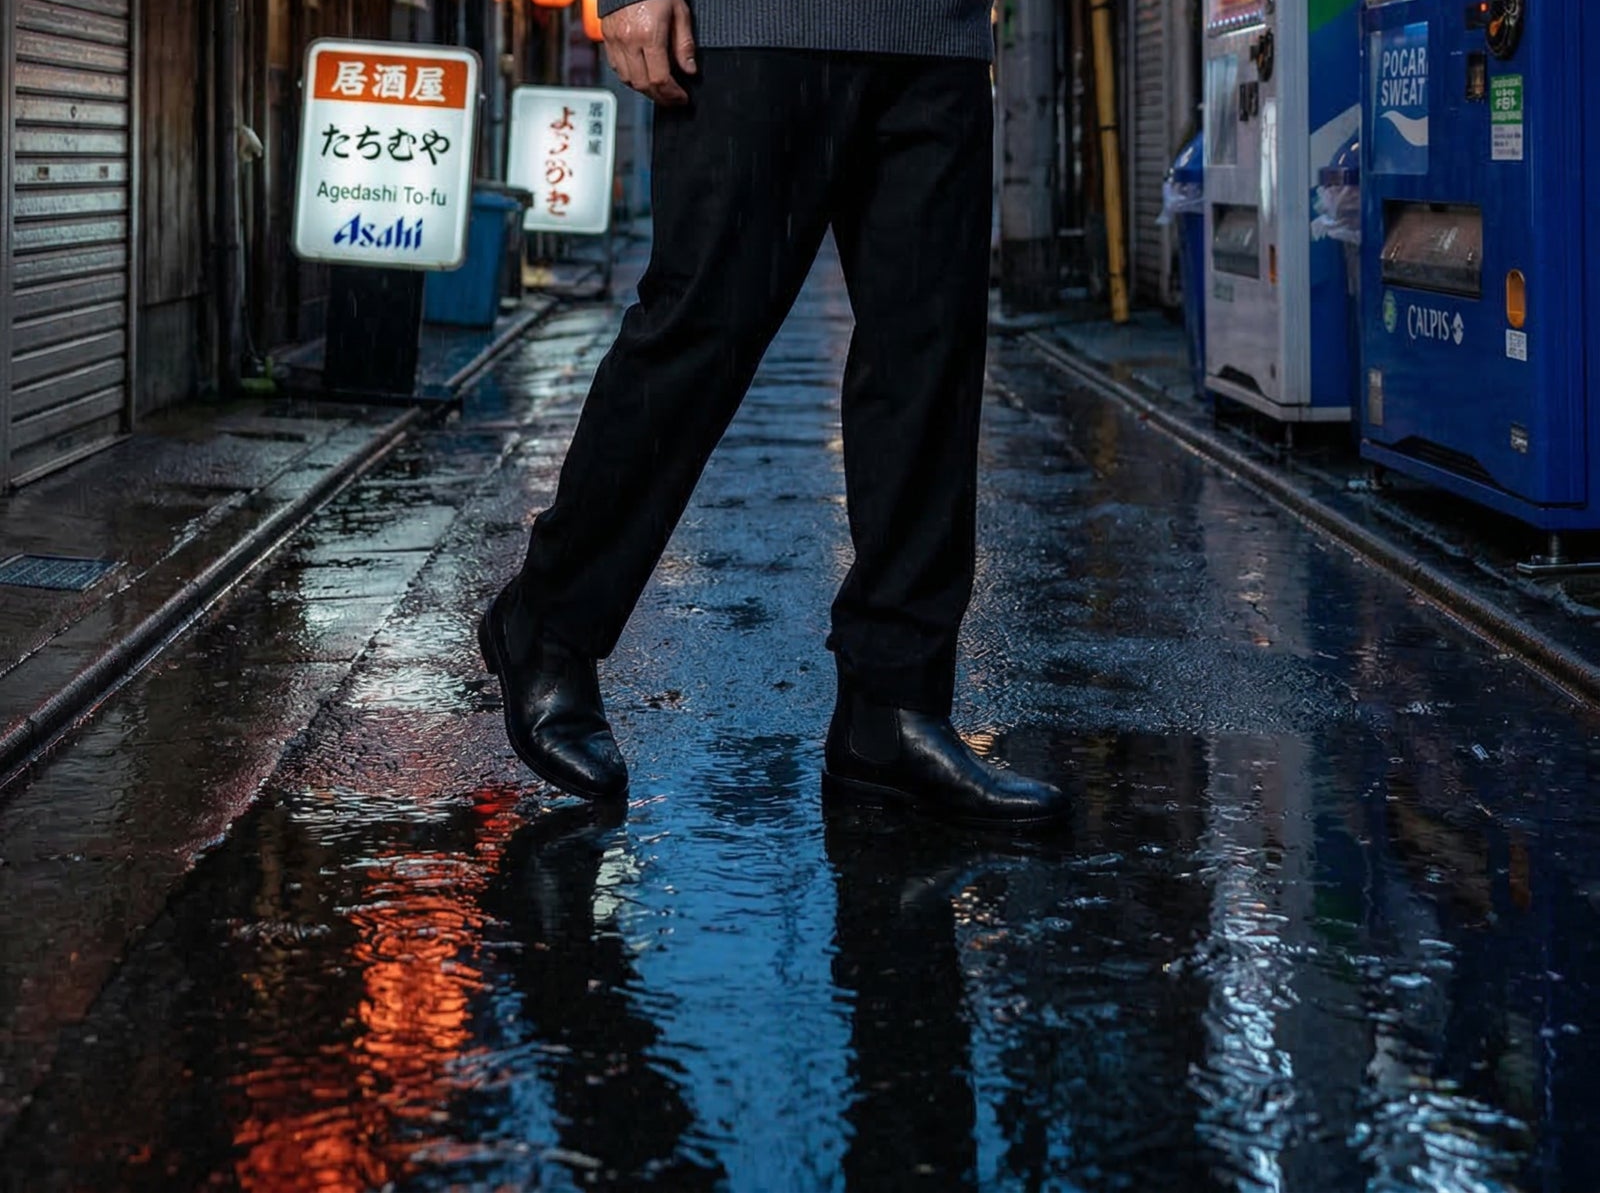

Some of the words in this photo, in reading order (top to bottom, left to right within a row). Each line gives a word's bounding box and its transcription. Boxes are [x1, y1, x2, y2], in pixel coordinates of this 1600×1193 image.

[1382, 47, 1428, 77] POCAR
[331, 61, 446, 102] 居酒屋
[1381, 77, 1426, 106] SWEAT
[321, 123, 451, 165] たちむや
[317, 181, 398, 203] Agedashi
[404, 186, 447, 206] To-fu
[333, 212, 423, 251] Asahi
[1408, 304, 1450, 341] CALPIS
